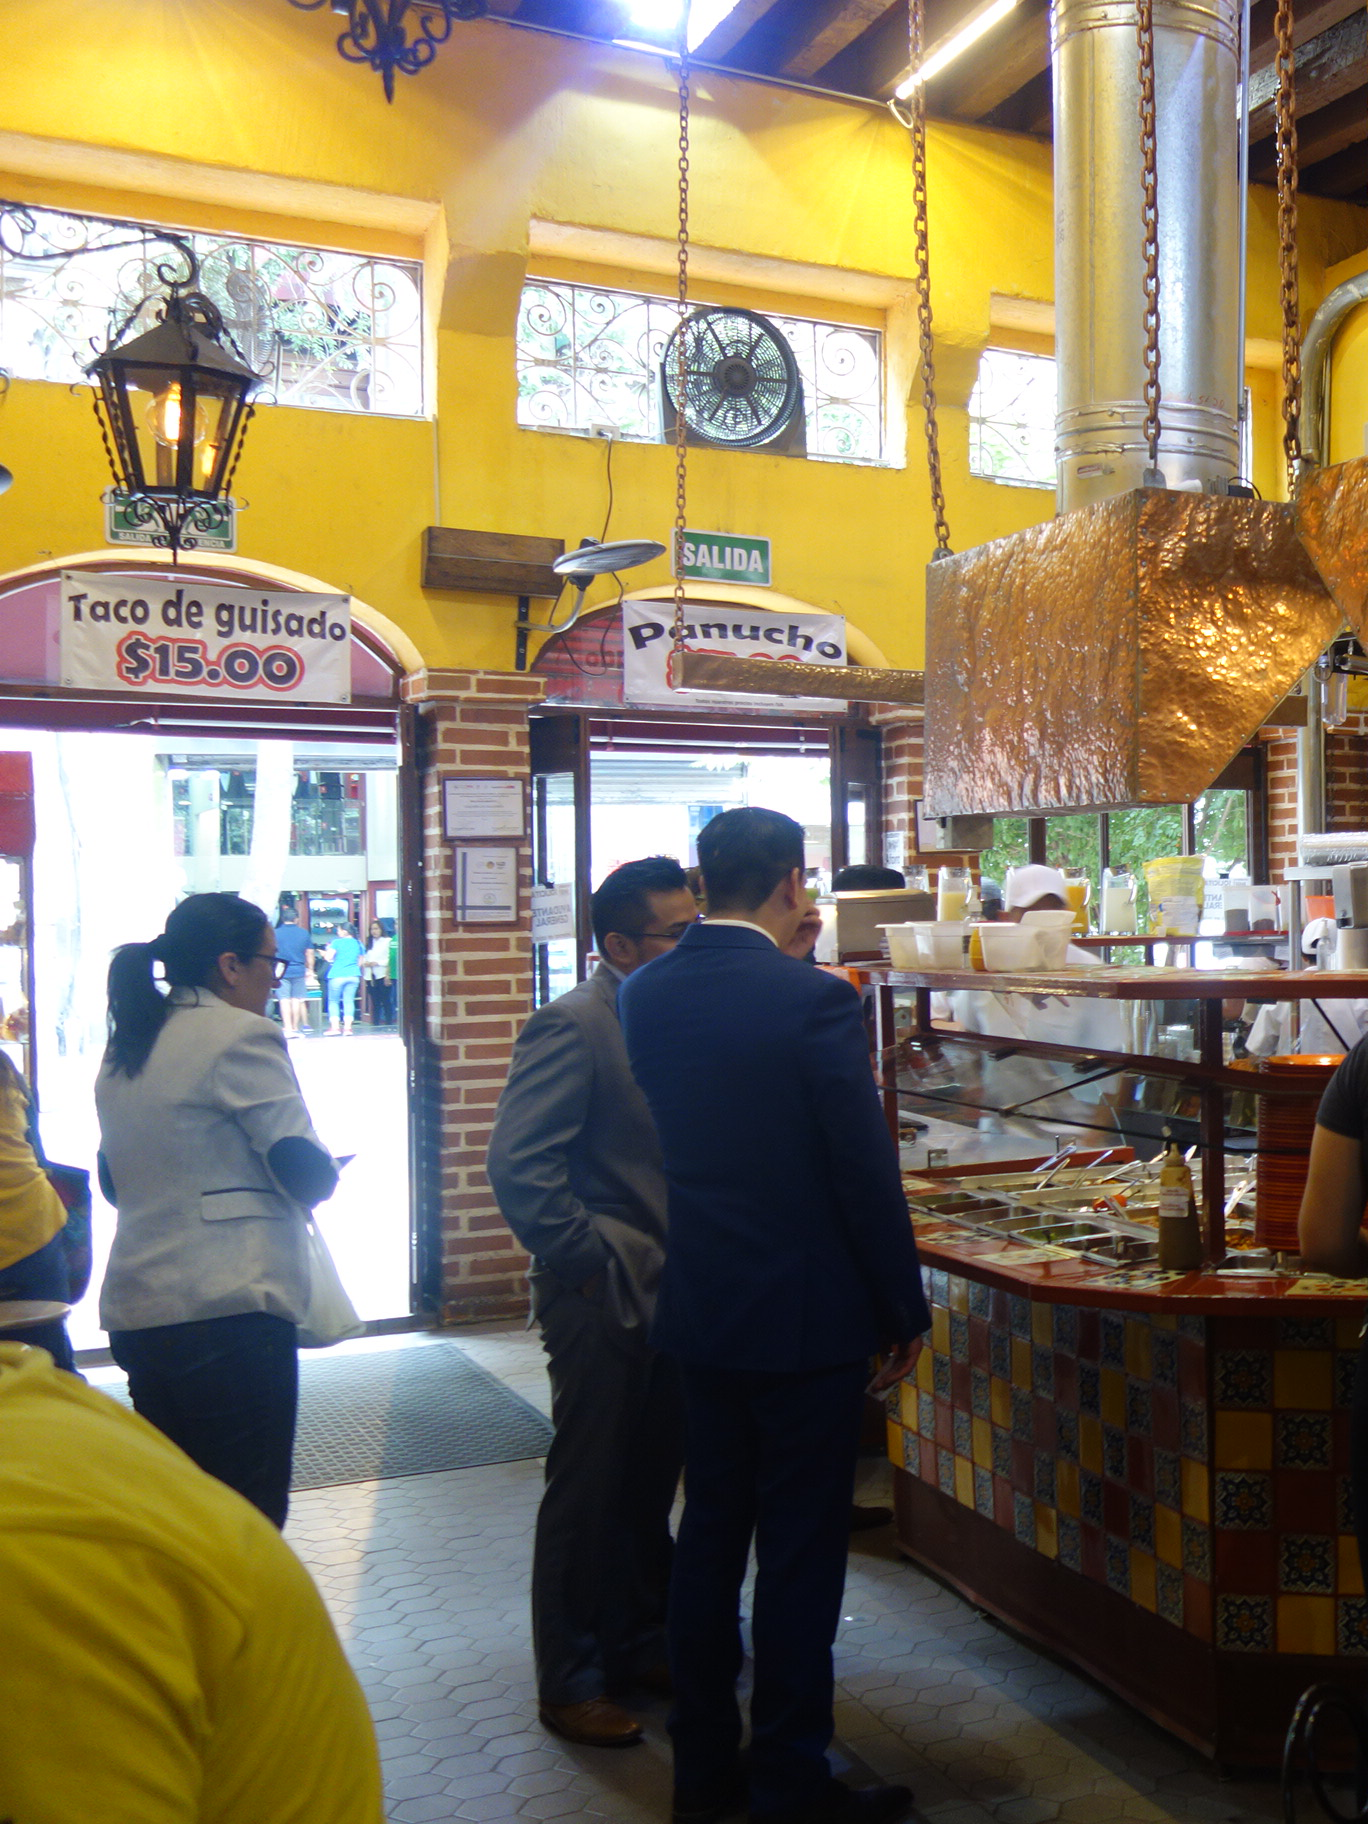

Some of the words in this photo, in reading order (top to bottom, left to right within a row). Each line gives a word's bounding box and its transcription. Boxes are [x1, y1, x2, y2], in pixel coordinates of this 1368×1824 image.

[118, 532, 152, 543] SALIDA
[682, 542, 764, 573] SALIDA
[68, 592, 151, 625] Taco
[161, 588, 204, 630] de
[214, 598, 347, 642] guisado
[628, 621, 843, 660] Panucho
[124, 636, 299, 687] $15.00
